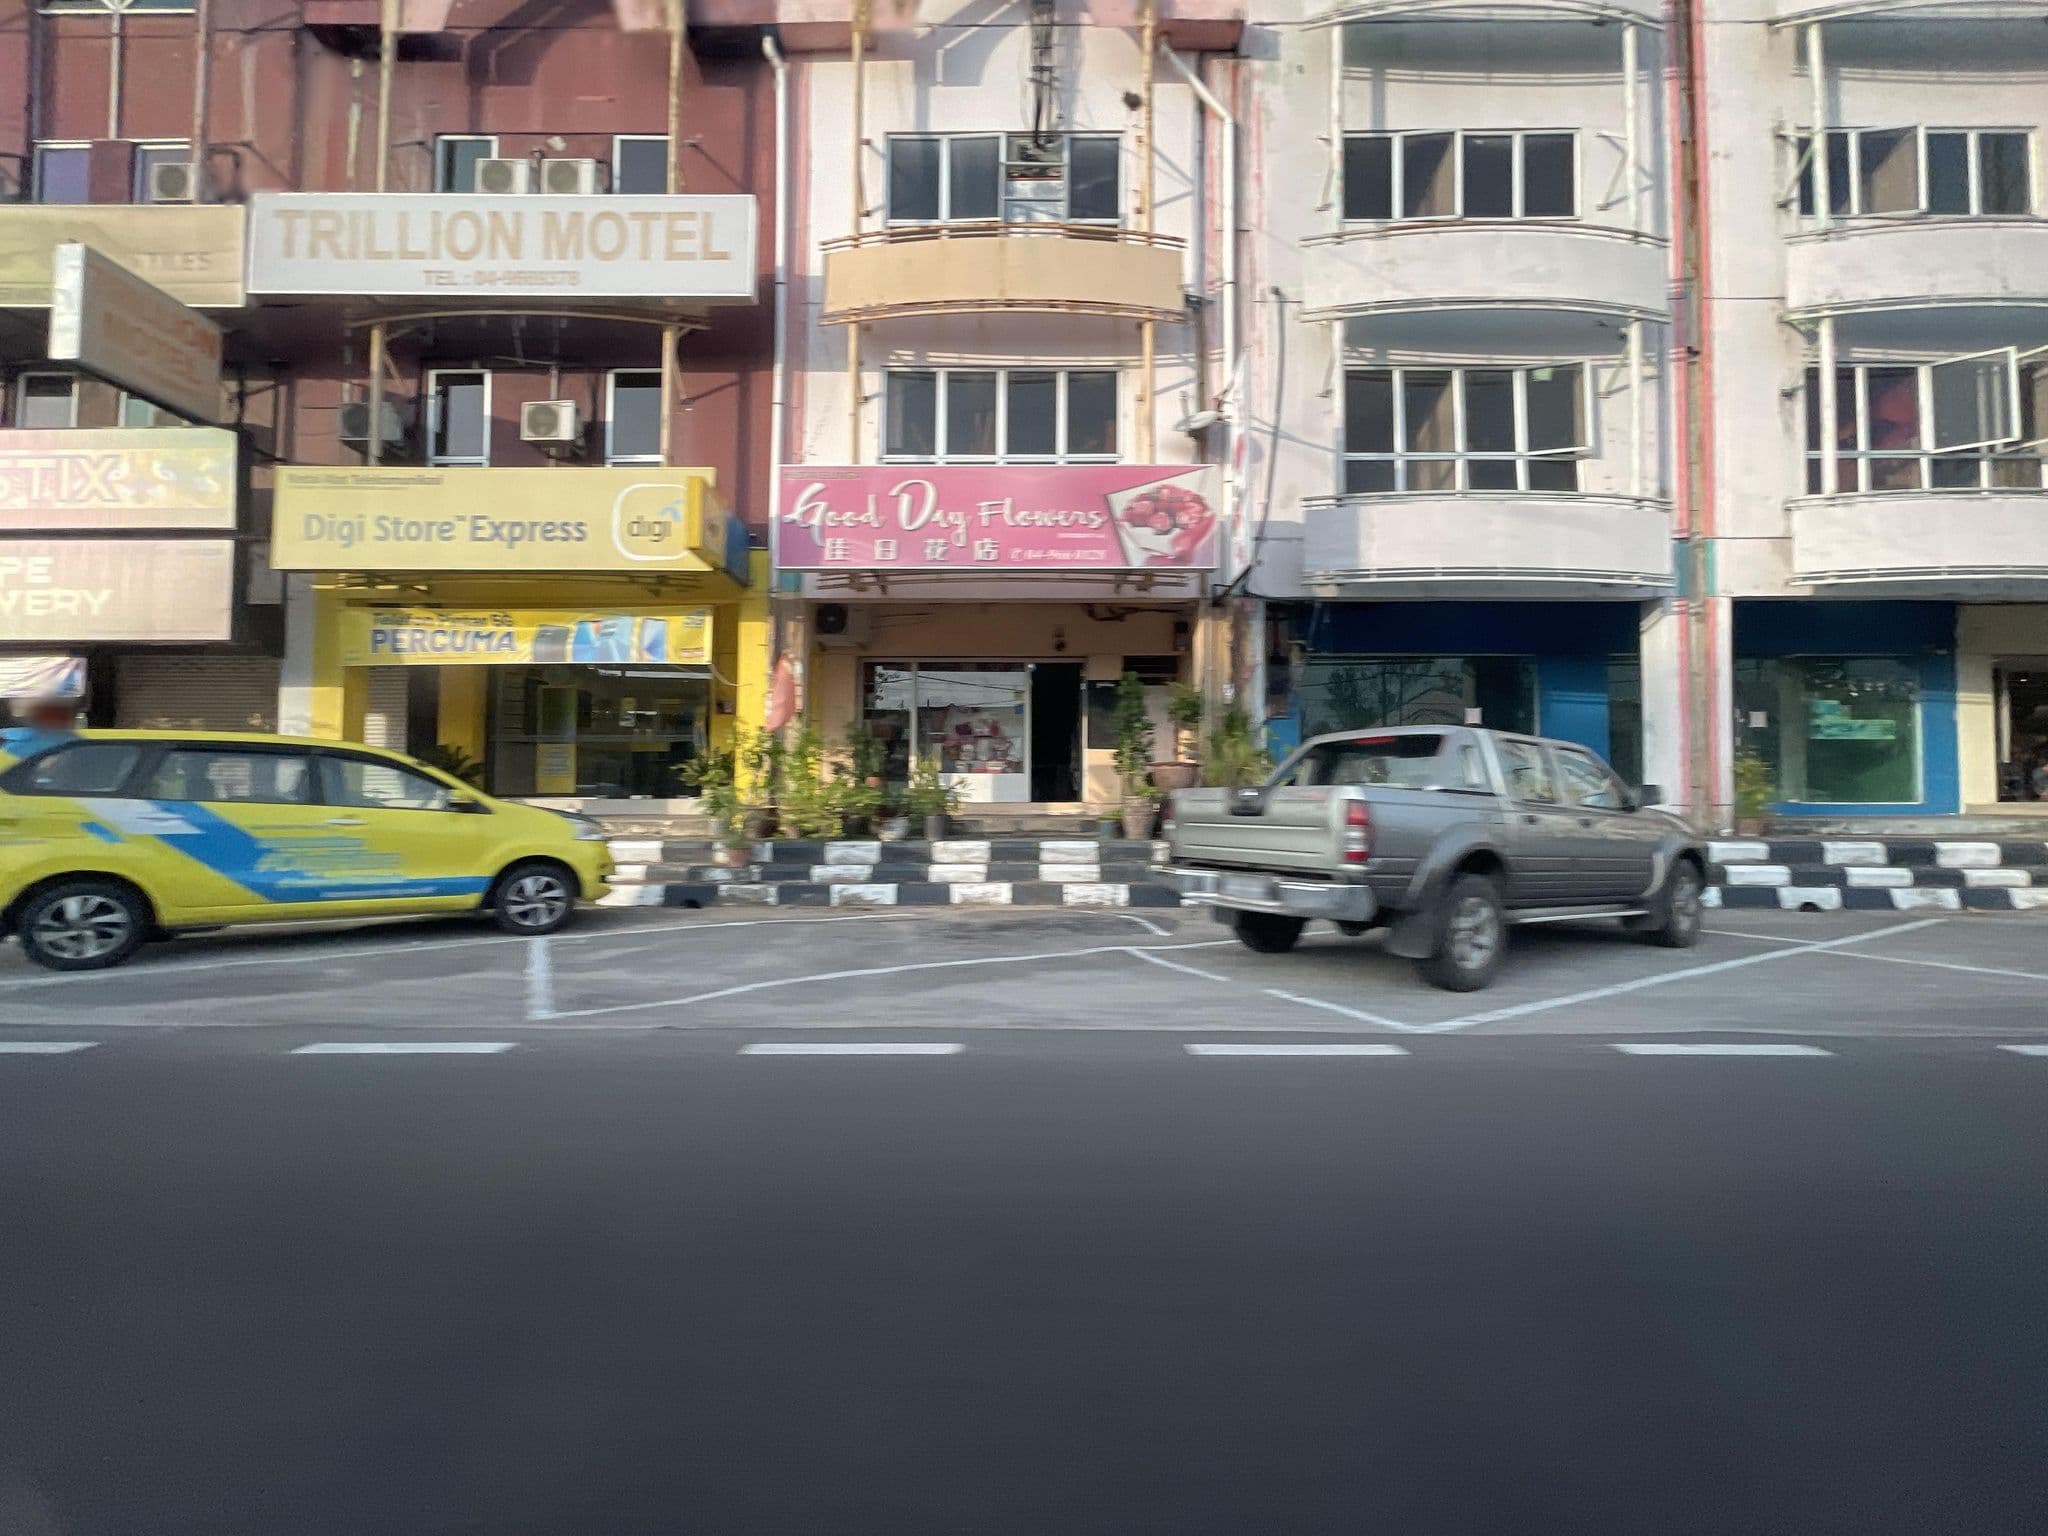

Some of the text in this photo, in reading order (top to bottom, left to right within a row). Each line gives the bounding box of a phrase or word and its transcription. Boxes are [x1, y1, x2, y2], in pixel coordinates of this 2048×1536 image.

[274, 209, 730, 261] TRILLION MOTEL
[304, 513, 364, 548] Digi
[470, 514, 587, 549] Express
[627, 516, 672, 542] digi
[784, 479, 1107, 548] Good Day Flowers
[371, 629, 516, 653] PERCUMA
